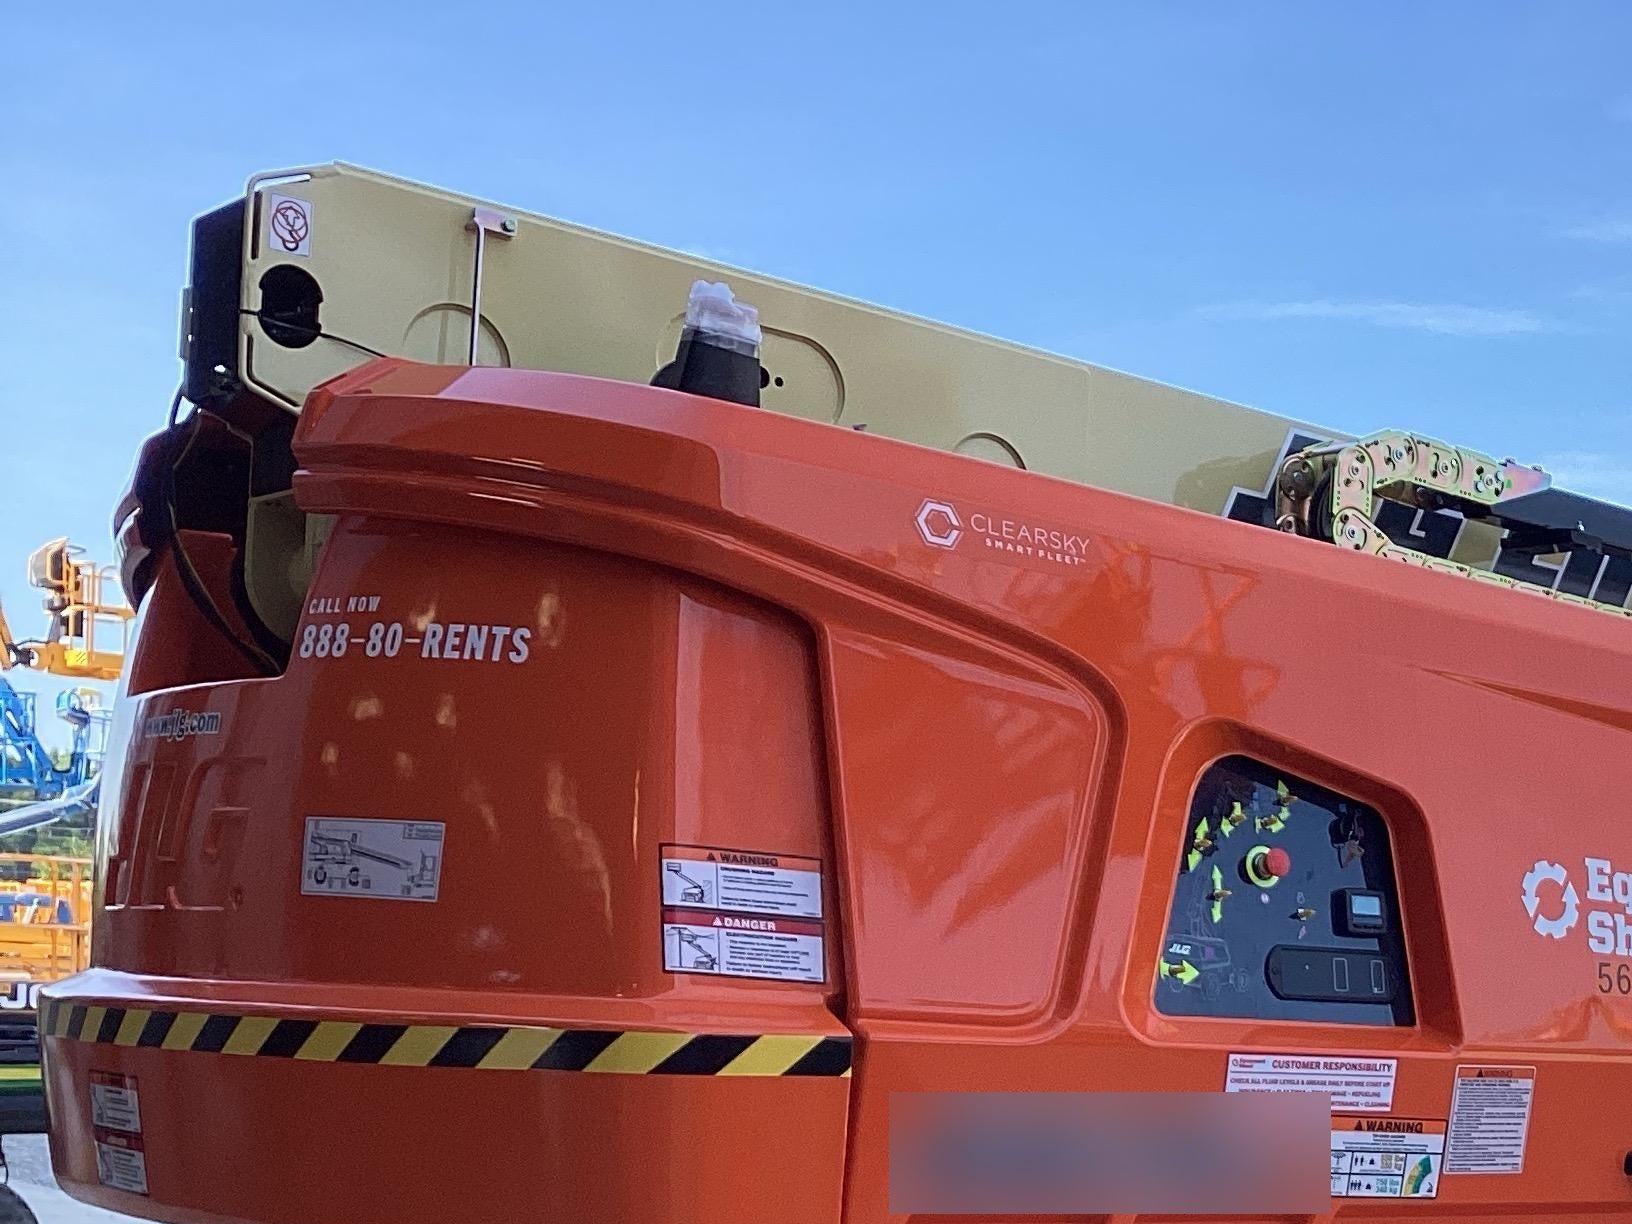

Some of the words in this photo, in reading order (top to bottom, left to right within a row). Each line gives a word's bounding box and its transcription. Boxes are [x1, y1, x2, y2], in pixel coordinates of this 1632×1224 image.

[970, 513, 1090, 554] CLEARSKY
[985, 537, 1033, 556] SMART
[1038, 549, 1081, 566] FLEET
[309, 598, 341, 614] CALL
[347, 596, 381, 612] NOW
[300, 622, 531, 664] 888-80-RENTS
[720, 852, 779, 867] WARNING
[724, 917, 777, 931] DANGER
[1169, 943, 1192, 956] JLG
[1272, 1059, 1321, 1070] CUSTOMER
[1323, 1060, 1393, 1073] RESPONSIBILITY
[1366, 1120, 1423, 1133] WARNING
